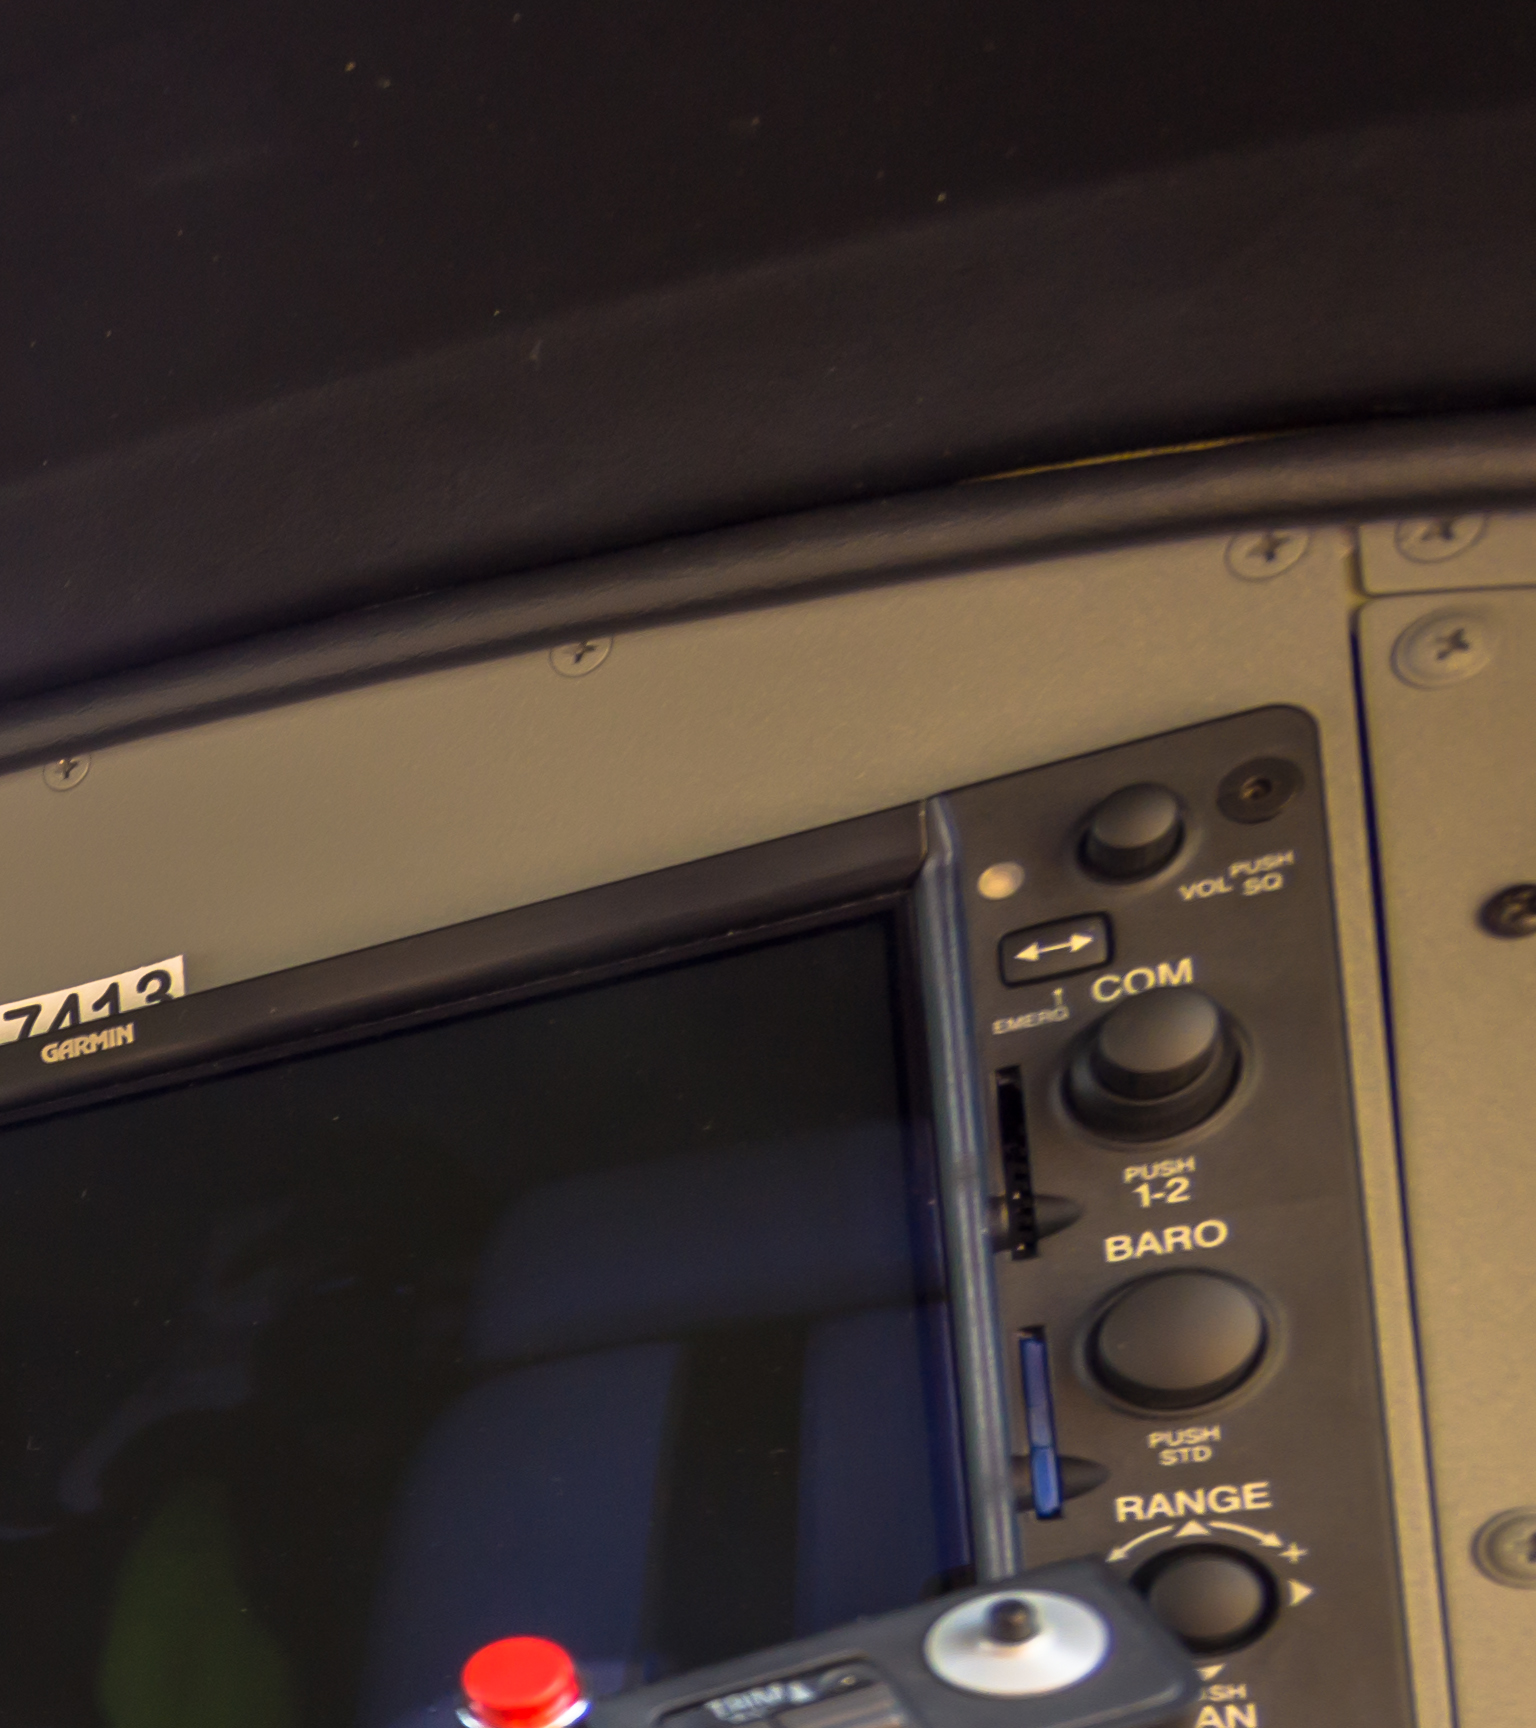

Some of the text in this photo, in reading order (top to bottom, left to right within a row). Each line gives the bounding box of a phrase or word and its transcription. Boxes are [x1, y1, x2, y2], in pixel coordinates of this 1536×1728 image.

[1231, 850, 1295, 878] PUSH
[1179, 876, 1232, 901] VOL
[1092, 958, 1194, 1002] COM
[40, 1022, 135, 1064] GARMIN
[1124, 1156, 1196, 1184] PUSH
[1133, 1177, 1191, 1208] 1-2
[1105, 1219, 1228, 1263] BARO
[1148, 1425, 1222, 1449] PUSH
[1158, 1444, 1212, 1466] STD
[1115, 1481, 1273, 1522] RANGE
